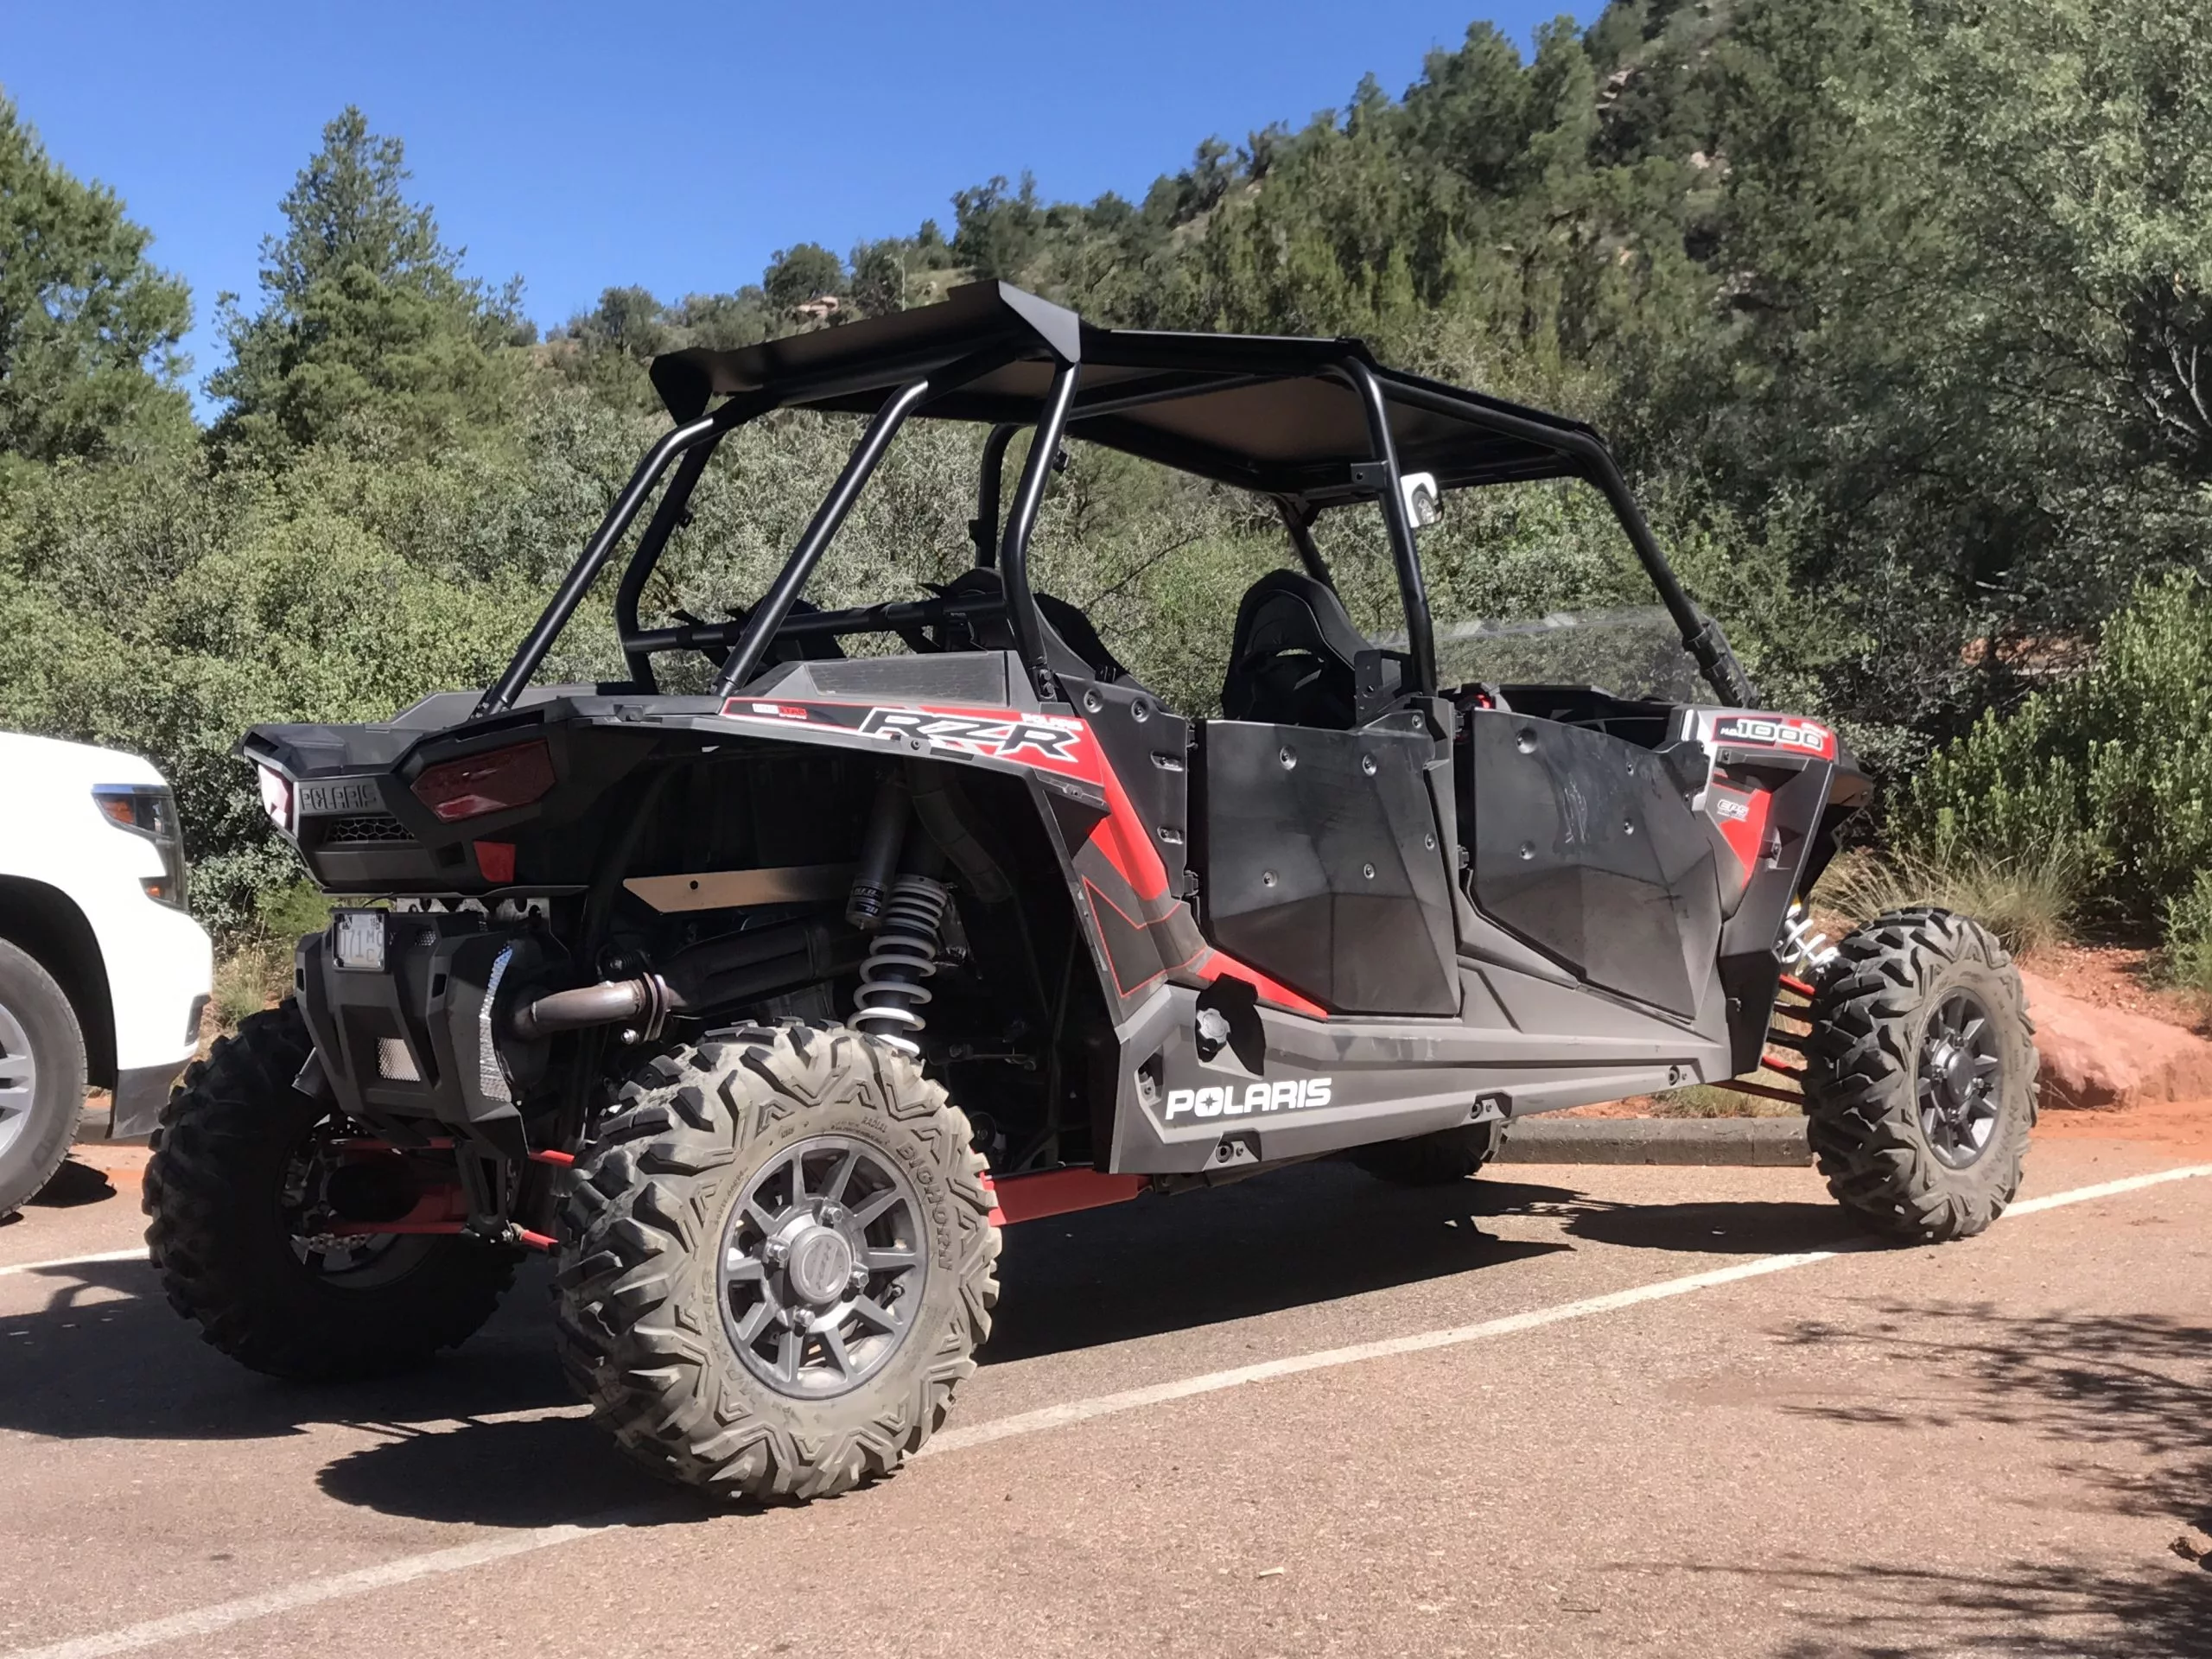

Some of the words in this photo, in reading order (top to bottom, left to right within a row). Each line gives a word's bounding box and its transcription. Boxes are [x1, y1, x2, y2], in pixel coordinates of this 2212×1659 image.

[858, 707, 1081, 762] RZR
[1737, 718, 1823, 751] 1000
[299, 785, 377, 810] POLARIS
[1717, 798, 1749, 817] EPS
[1165, 1077, 1332, 1121] POLARIS
[896, 1141, 953, 1271] BIGHORN
